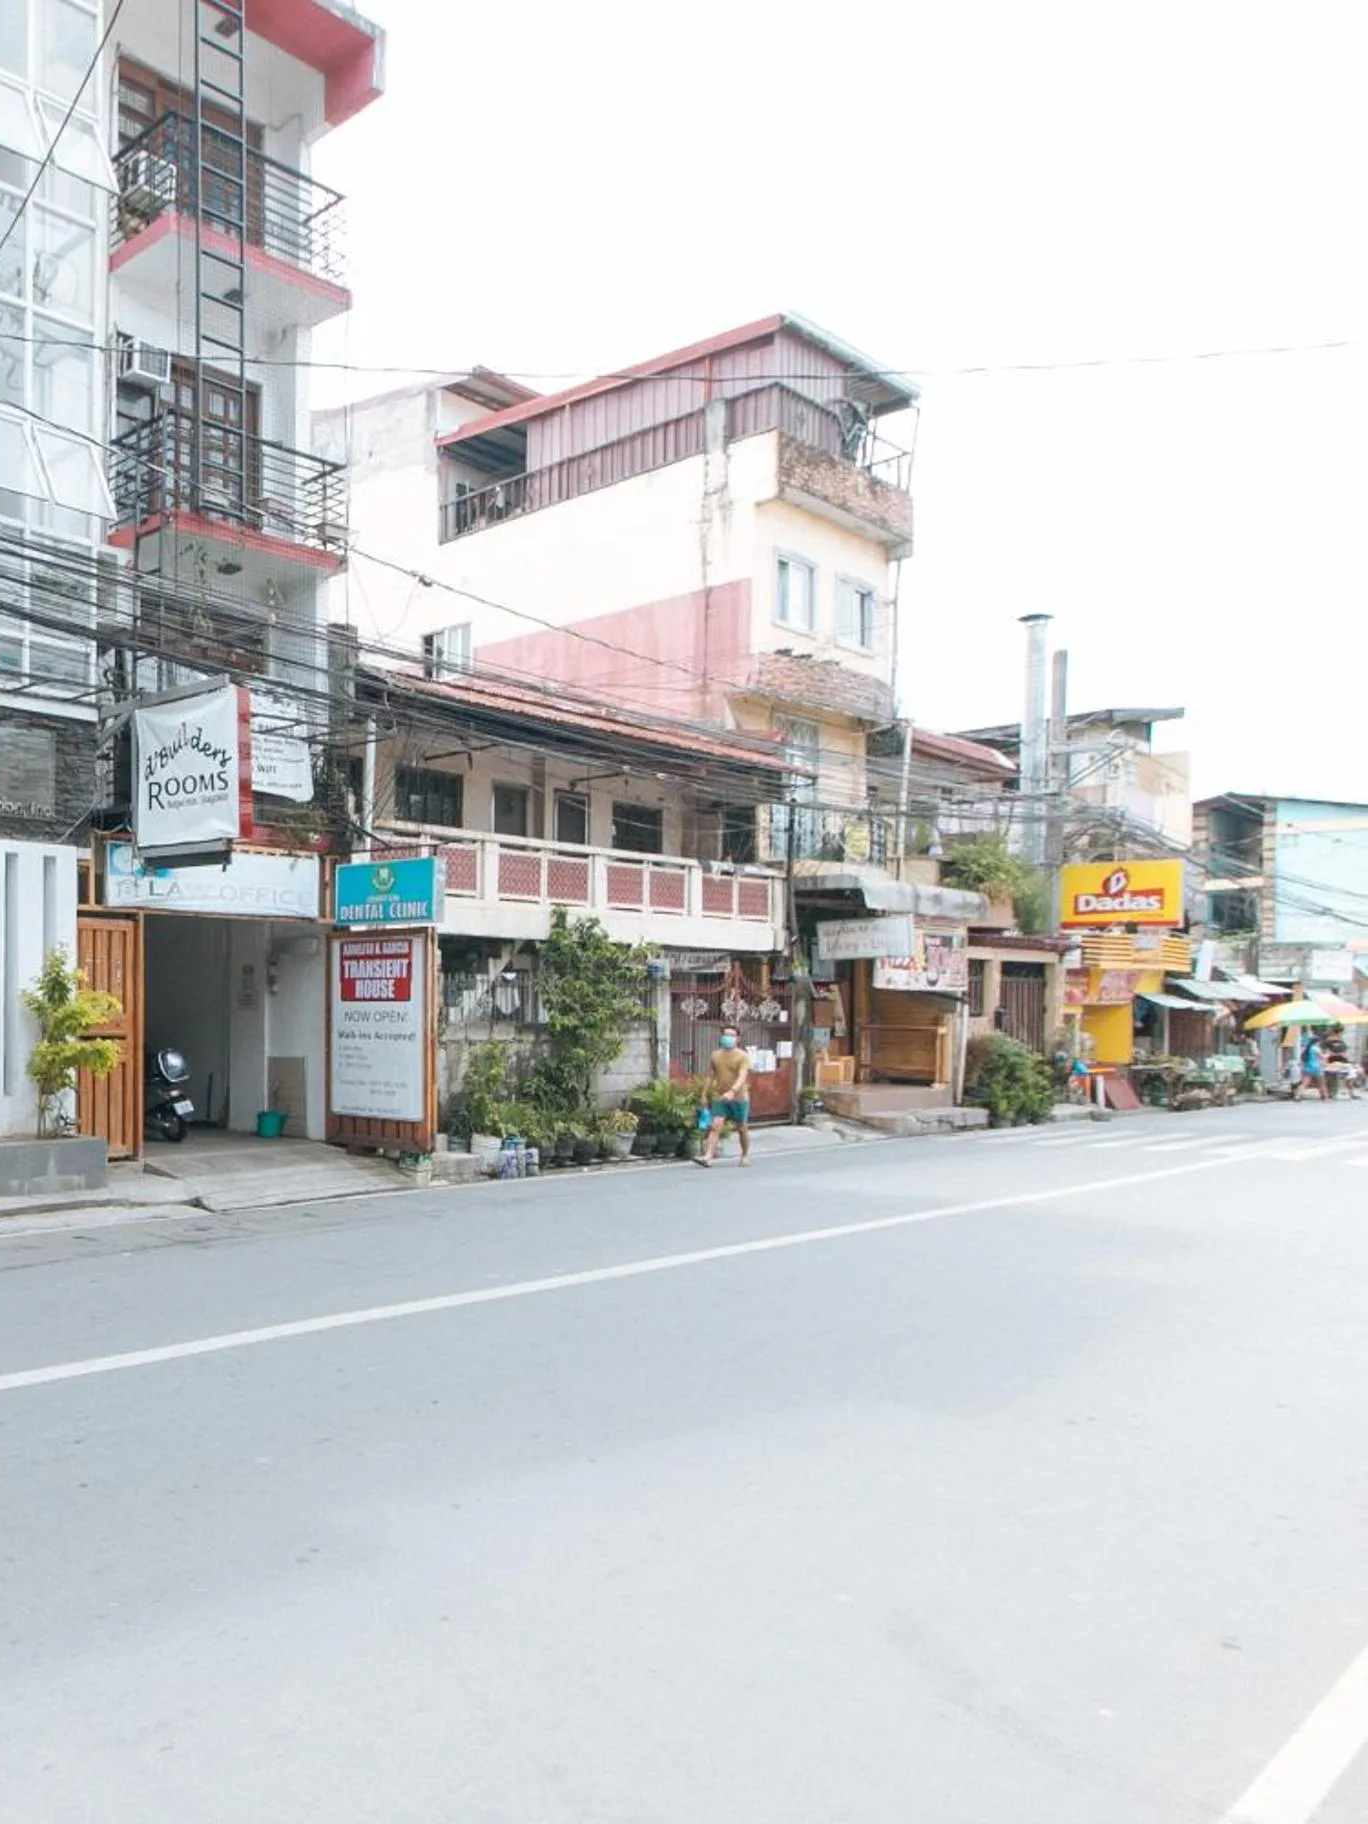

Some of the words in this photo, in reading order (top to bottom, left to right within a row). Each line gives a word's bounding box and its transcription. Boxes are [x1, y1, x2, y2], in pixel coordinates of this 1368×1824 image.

[147, 770, 230, 811] ROOMS
[219, 886, 312, 908] OFFICE
[1077, 892, 1161, 913] Dadas
[340, 903, 384, 920] DENTAL
[389, 901, 428, 918] CLINIC
[342, 959, 409, 979] TRANSIENT
[355, 979, 396, 999] HOUSE
[344, 1010, 370, 1022] NOW
